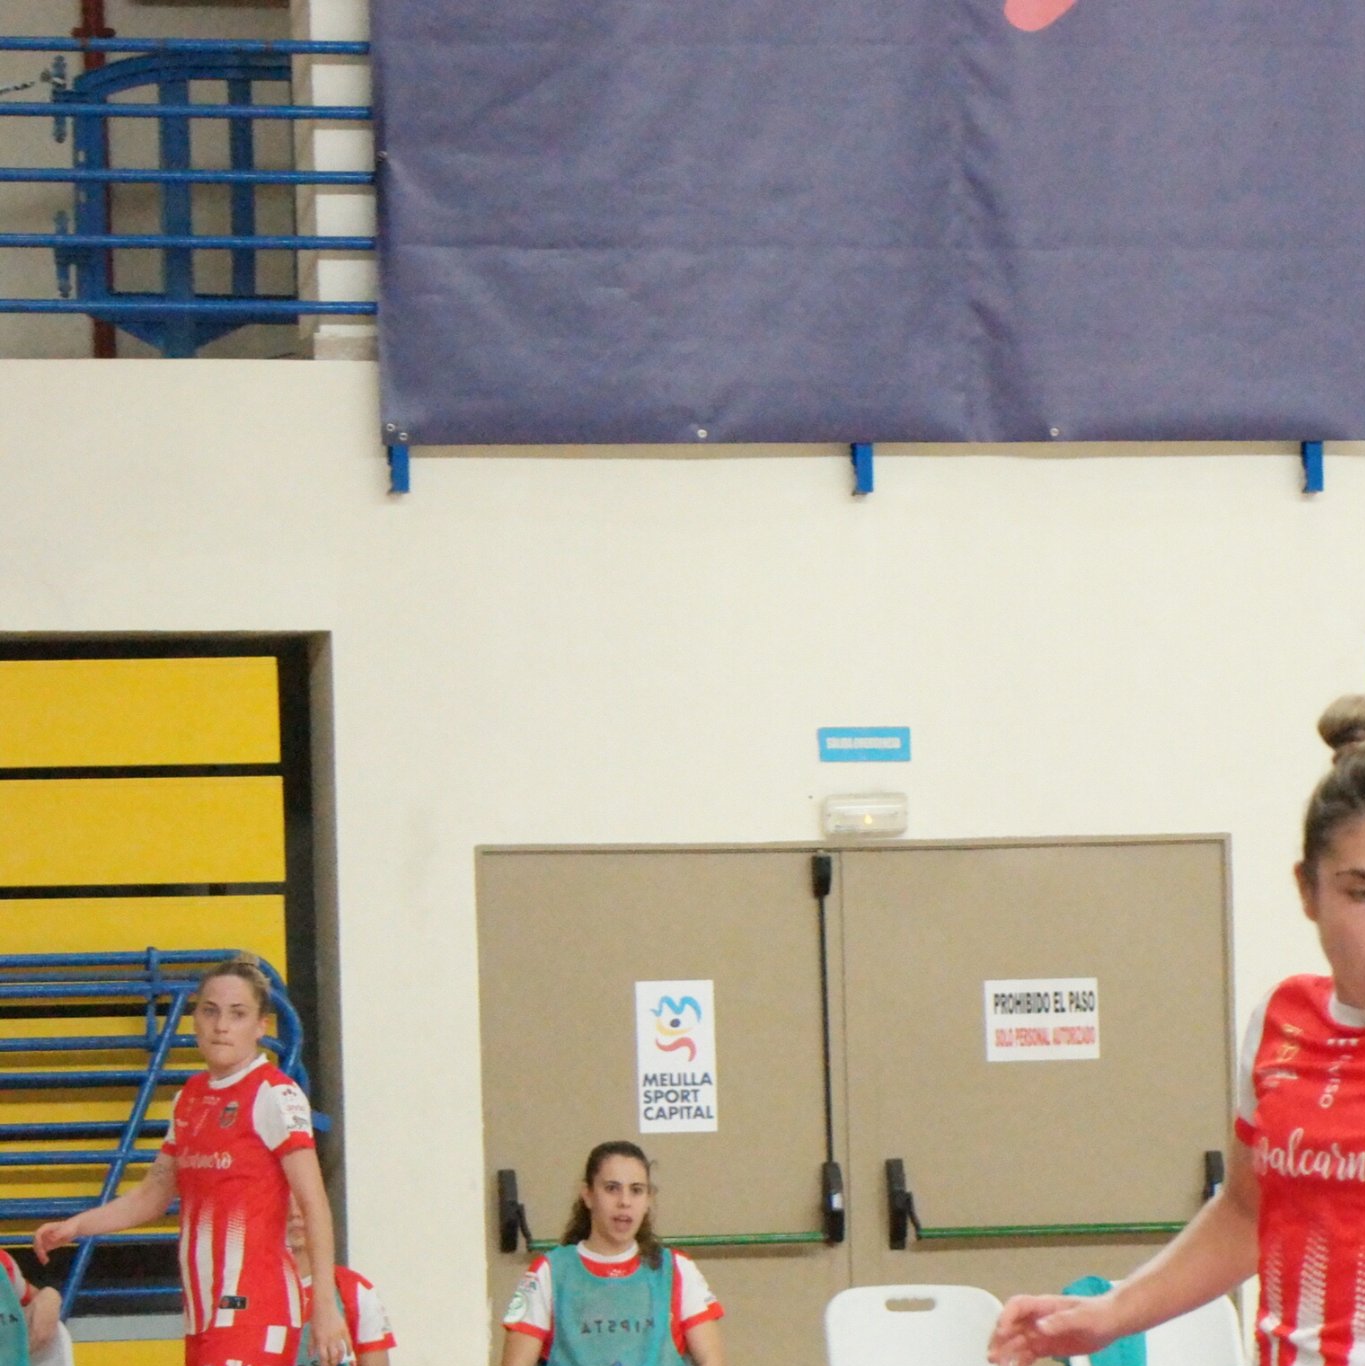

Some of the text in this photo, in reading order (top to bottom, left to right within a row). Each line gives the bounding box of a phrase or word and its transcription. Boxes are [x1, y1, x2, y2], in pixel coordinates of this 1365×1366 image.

[994, 990, 1094, 1015] PROHIBIDO EL PASO
[643, 1072, 712, 1087] MELILLA
[643, 1089, 700, 1103] SPORT
[643, 1105, 714, 1120] CAPITAL
